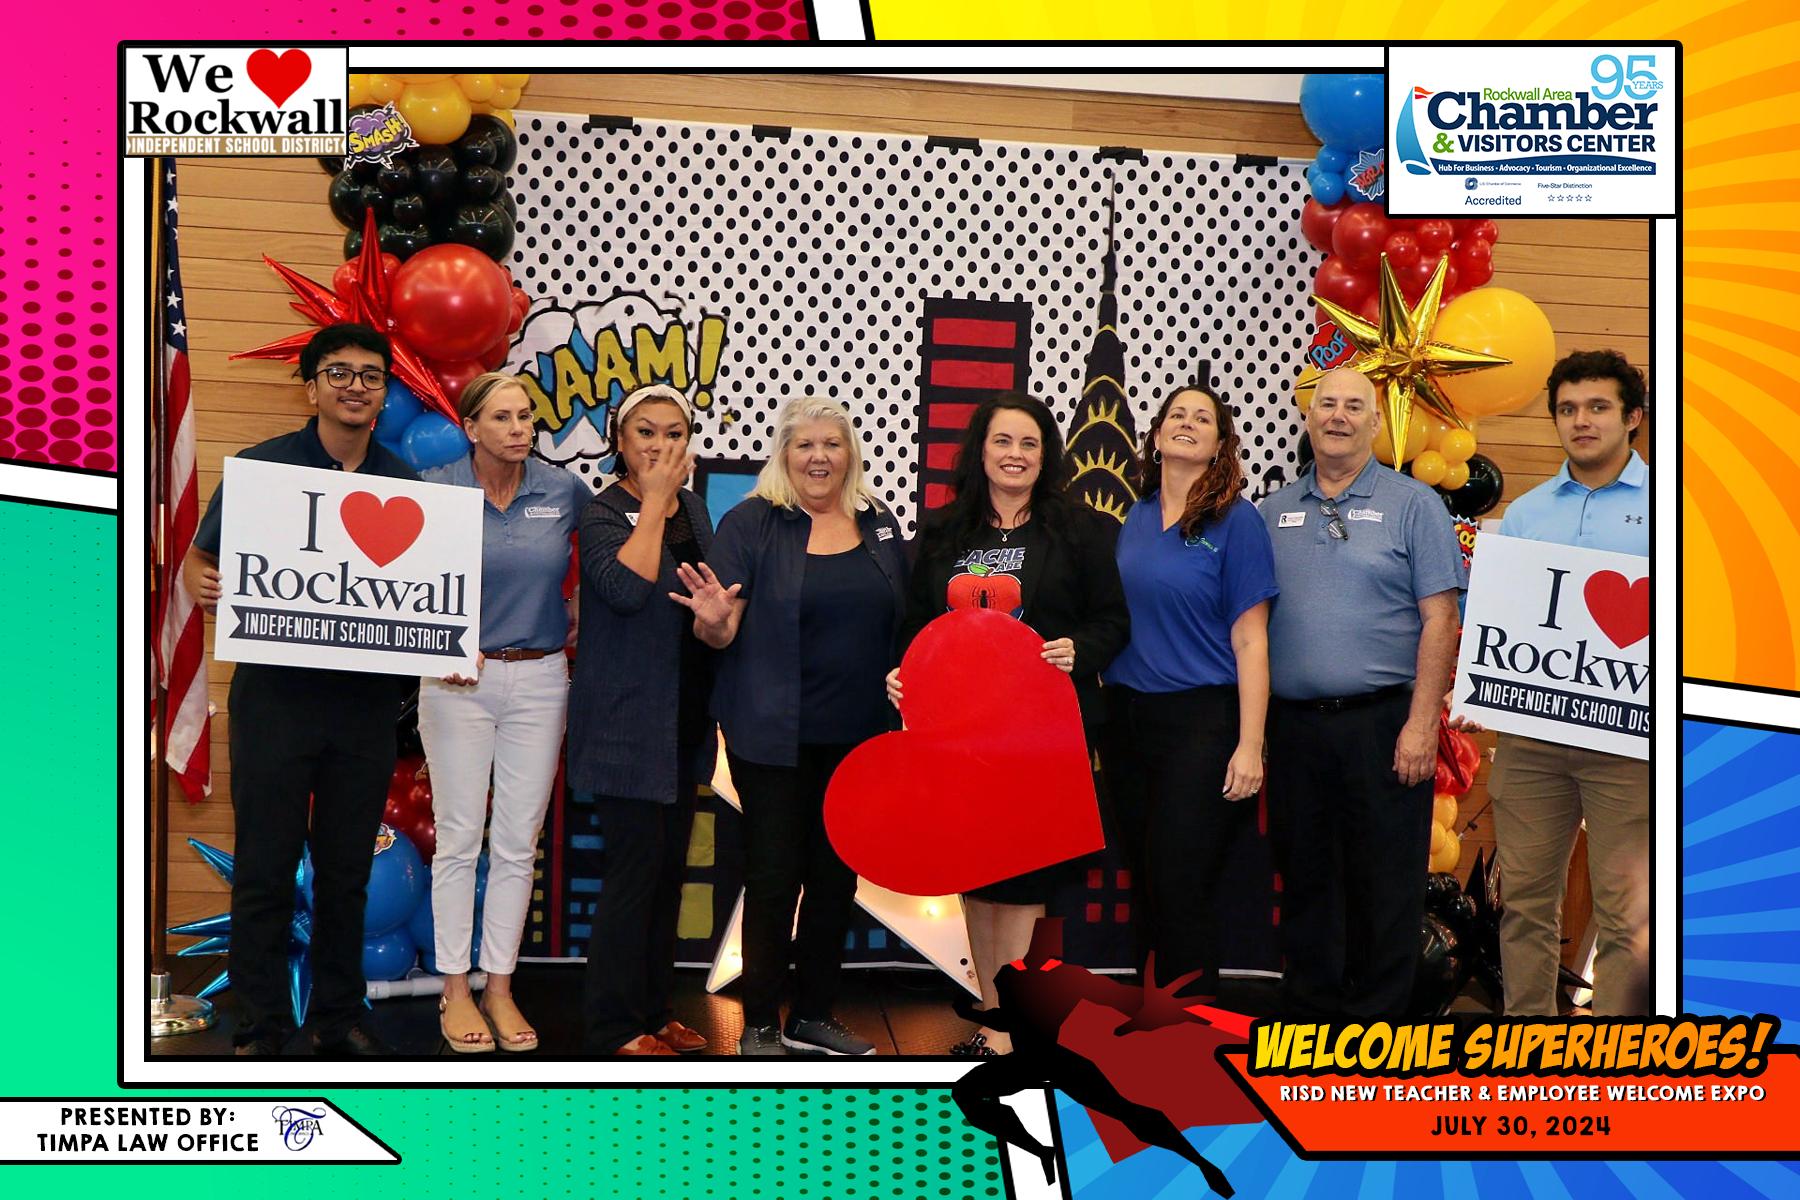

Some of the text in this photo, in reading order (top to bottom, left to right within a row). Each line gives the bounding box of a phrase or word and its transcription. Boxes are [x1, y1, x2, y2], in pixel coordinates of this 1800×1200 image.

[1311, 329, 1348, 369] POOF
[300, 490, 326, 553] I
[233, 551, 468, 617] Rockwall
[953, 547, 1026, 567] ACHE
[1538, 567, 1571, 631] I
[244, 611, 452, 651] INDEPENDENT SCHOOL DISTRICT
[1471, 623, 1649, 695] Rockw
[1478, 680, 1569, 717] INDEPENDENT
[1570, 699, 1624, 728] SCHOOL
